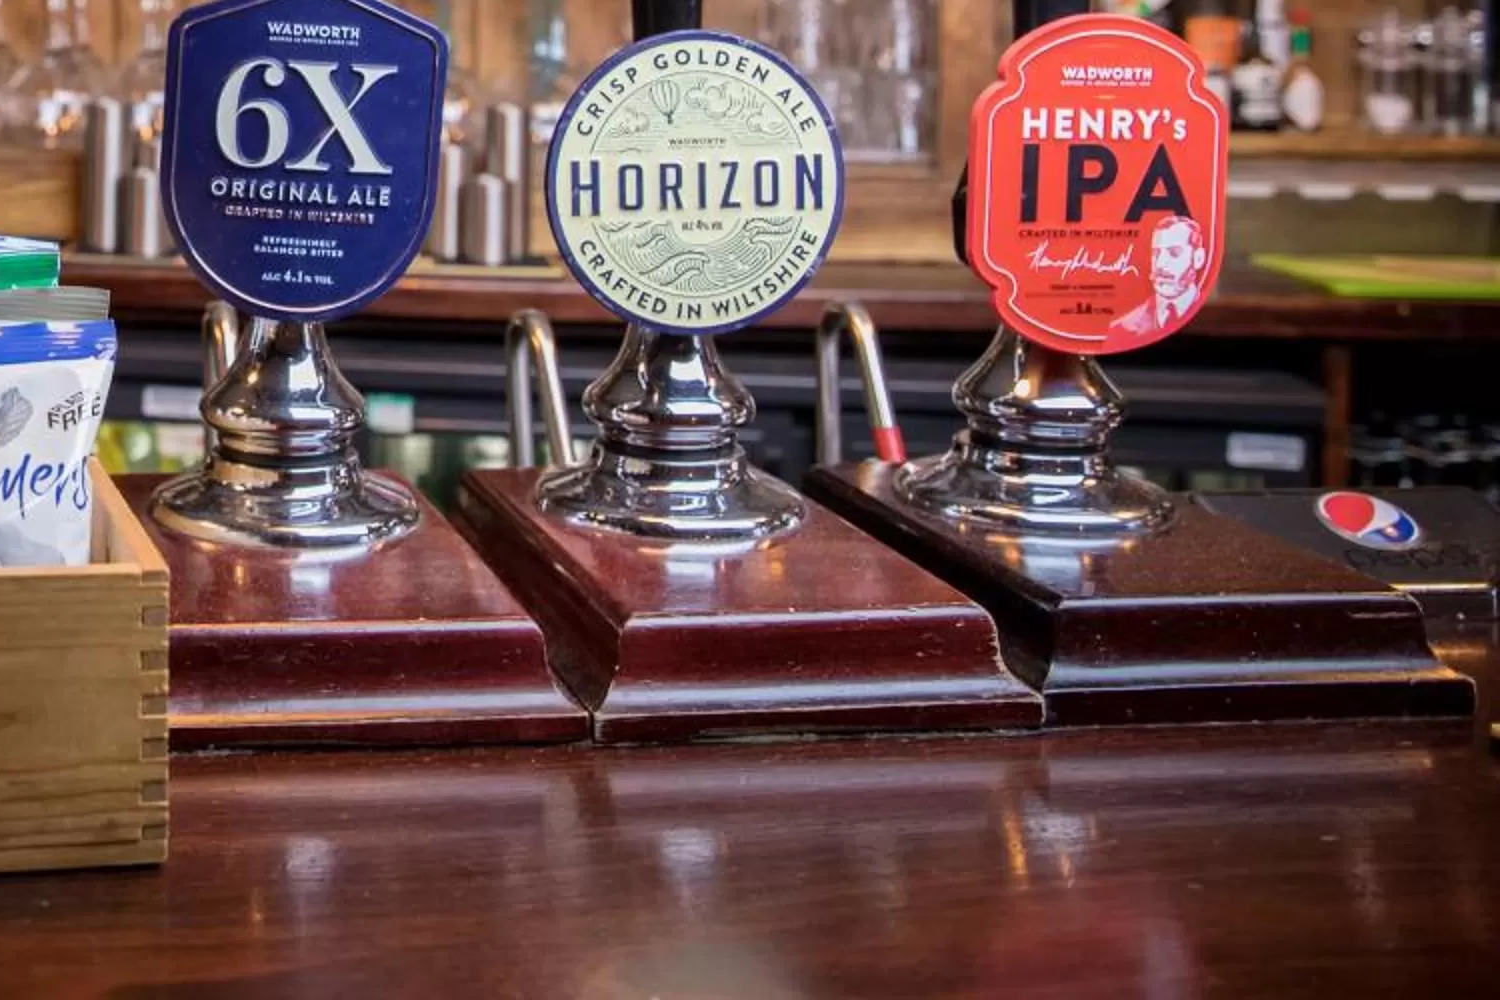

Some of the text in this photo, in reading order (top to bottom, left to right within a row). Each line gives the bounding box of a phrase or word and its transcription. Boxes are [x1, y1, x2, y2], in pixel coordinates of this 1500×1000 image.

[267, 21, 360, 39] WADWORTH
[1062, 66, 1152, 80] WADWORTH
[577, 48, 817, 137] CRISP GOLDEN ALE
[215, 57, 398, 175] 6X
[1021, 107, 1187, 140] HENRY's
[211, 178, 391, 206] ORIGINAL ALE
[569, 154, 823, 217] HORIZON
[1019, 143, 1194, 223] IPA
[225, 205, 375, 225] CRAFTED IN WILTSHIRE
[1019, 229, 1066, 238] CRAFTED
[1070, 230, 1081, 238] IN
[253, 244, 344, 258] BALANCED BITTER
[261, 272, 281, 281] ALC
[579, 232, 818, 320] CRAFTED IN WILTSHIRE
